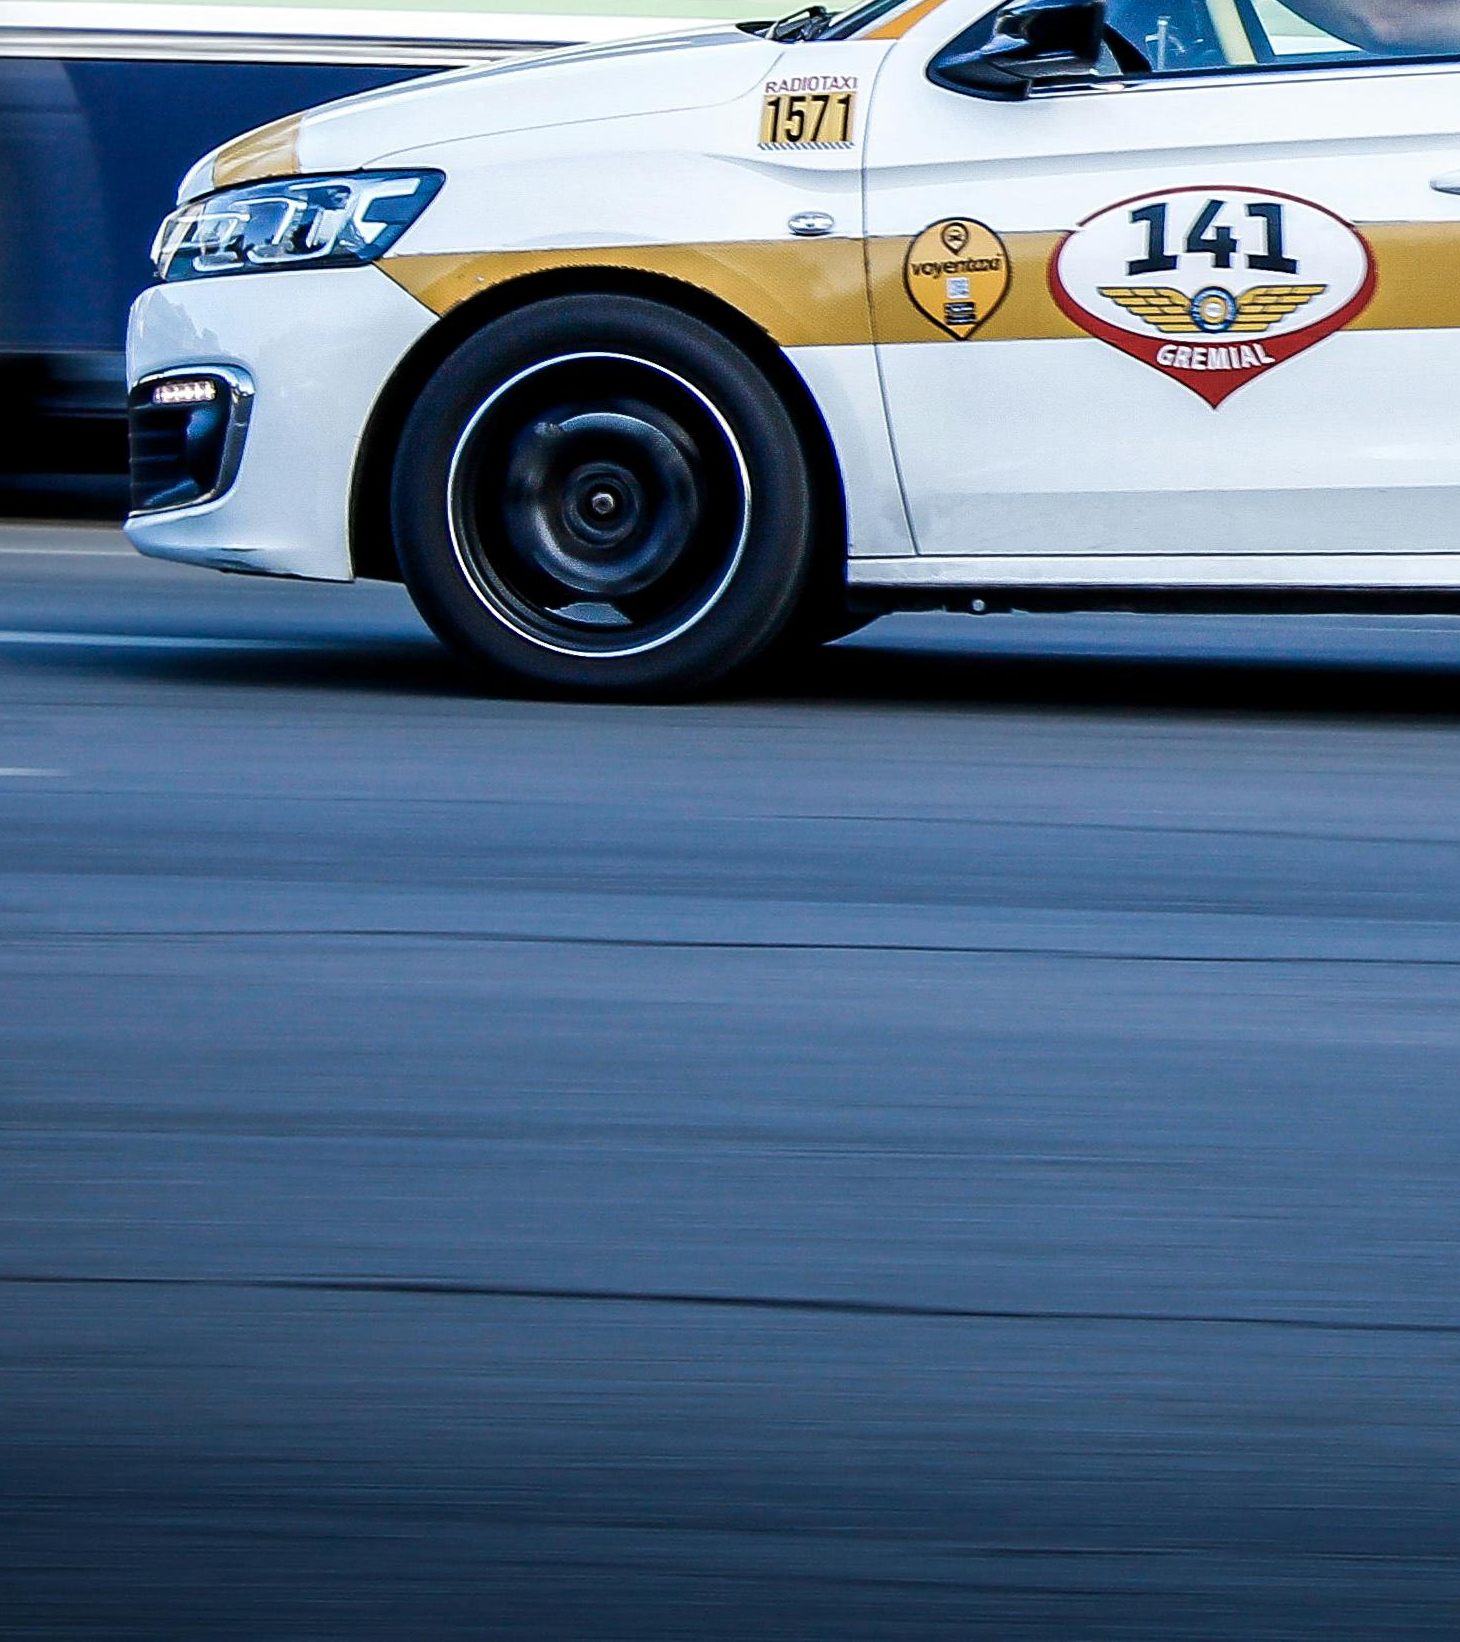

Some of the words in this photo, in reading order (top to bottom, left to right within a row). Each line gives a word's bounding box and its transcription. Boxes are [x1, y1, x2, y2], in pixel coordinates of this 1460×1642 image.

[764, 75, 858, 94] RADIOTAXI
[766, 93, 851, 143] 1571
[1126, 198, 1299, 277] 141
[1155, 342, 1276, 371] GREMIAL
